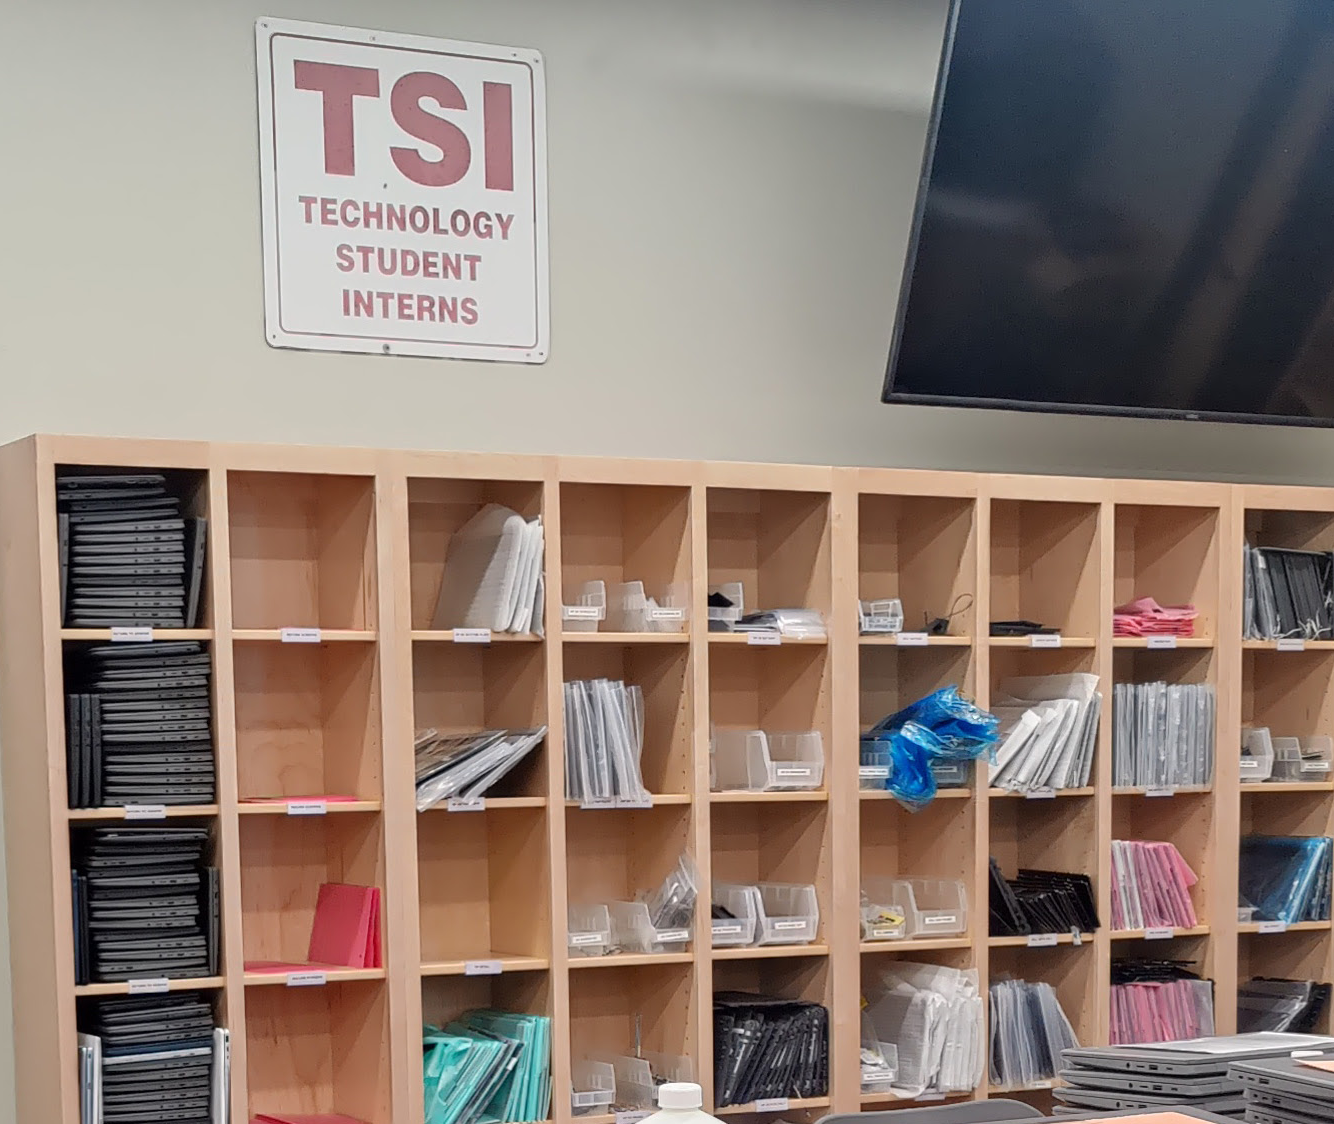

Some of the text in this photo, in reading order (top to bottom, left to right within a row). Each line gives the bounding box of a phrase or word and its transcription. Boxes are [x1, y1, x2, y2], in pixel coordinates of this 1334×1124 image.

[293, 59, 514, 191] TSI
[298, 195, 514, 240] TECHNOLOGY
[336, 243, 482, 281] STUDENT
[342, 288, 479, 326] INTERNS
